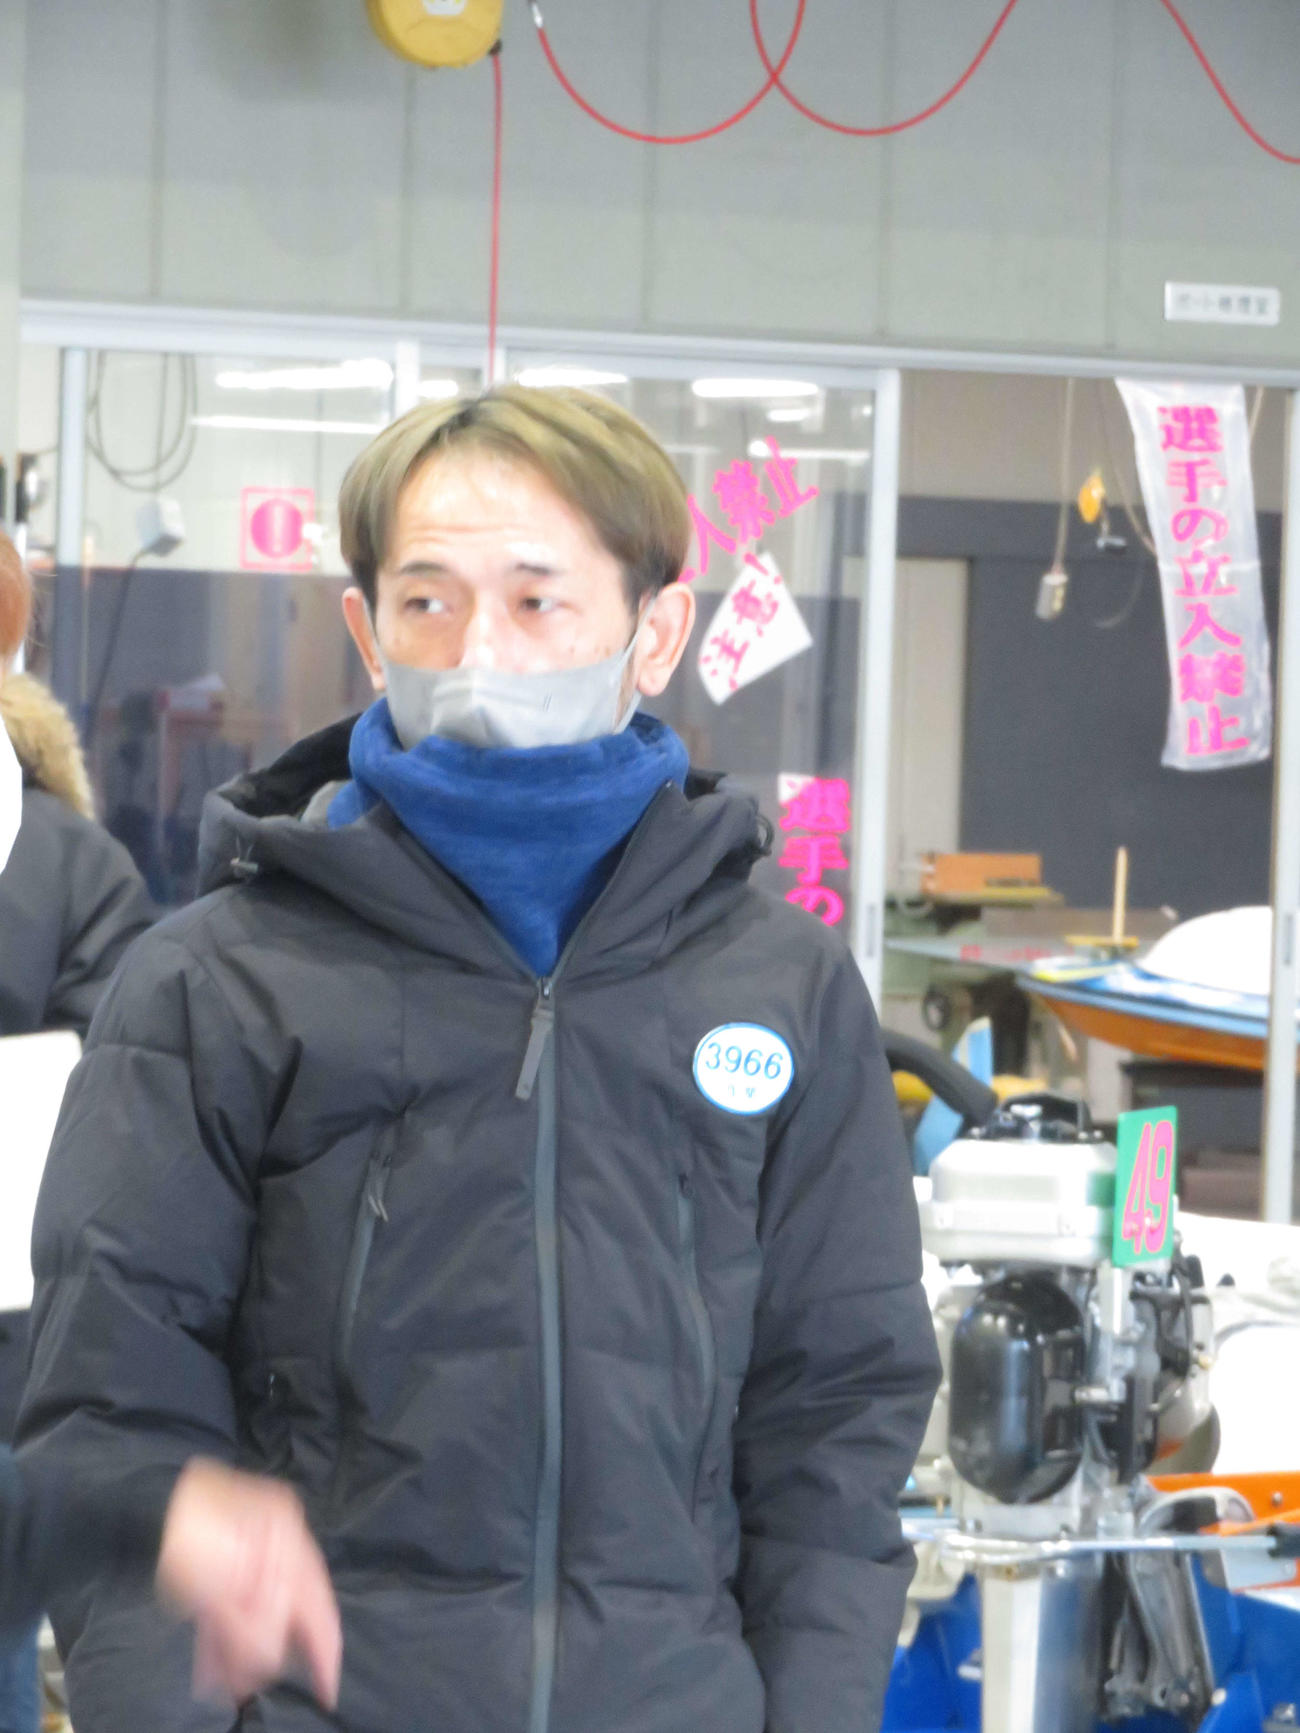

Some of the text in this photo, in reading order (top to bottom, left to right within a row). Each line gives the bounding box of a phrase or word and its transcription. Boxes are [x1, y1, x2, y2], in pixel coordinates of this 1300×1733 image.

[678, 434, 819, 584] 入禁止
[705, 1041, 784, 1080] 3966
[1121, 1119, 1174, 1255] 49
